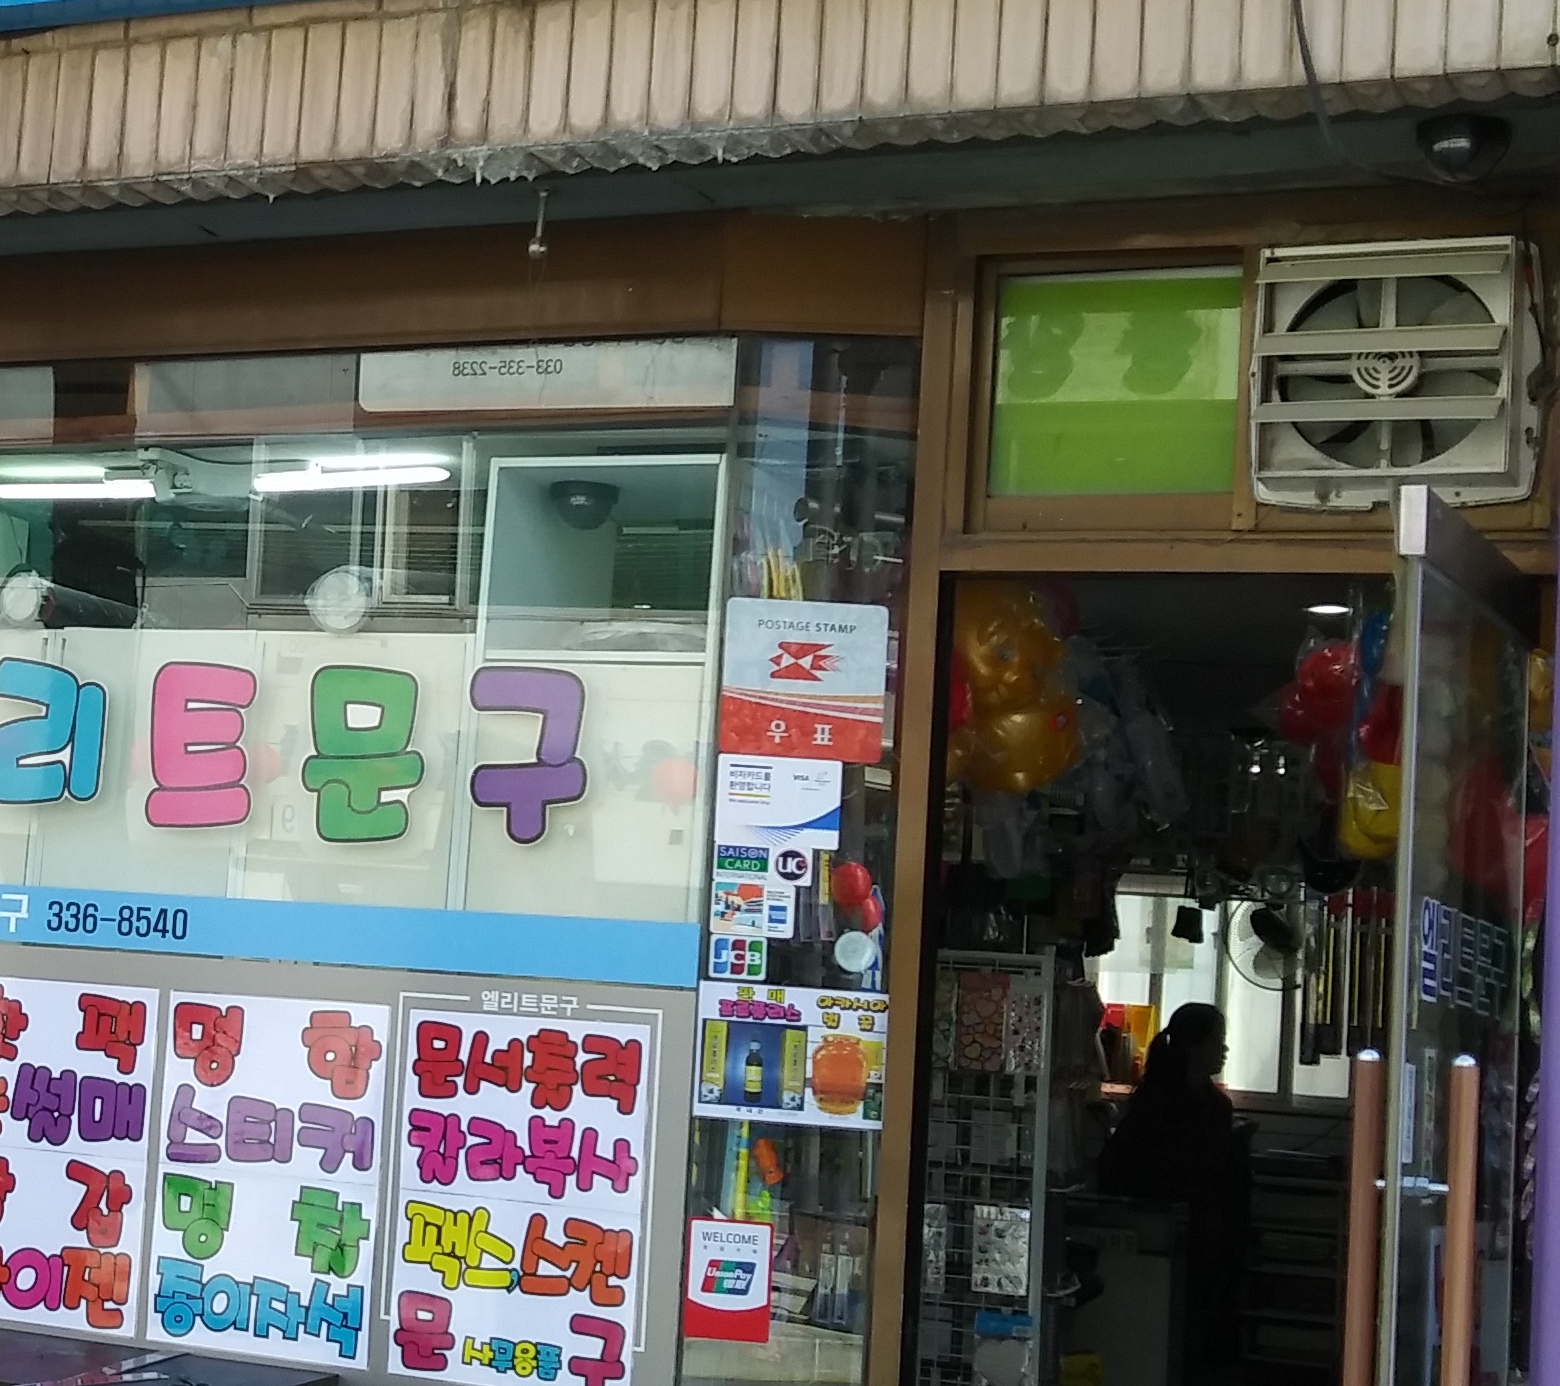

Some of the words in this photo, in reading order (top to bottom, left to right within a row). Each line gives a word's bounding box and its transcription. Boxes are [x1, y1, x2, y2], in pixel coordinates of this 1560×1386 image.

[758, 619, 812, 632] POSTAGE
[815, 622, 858, 634] STAMP
[766, 719, 834, 746] 우표
[719, 846, 768, 859] SAISON
[725, 858, 761, 871] CARD
[778, 856, 807, 875] UC
[46, 898, 190, 943] 336-8540
[1420, 896, 1508, 1021] 엘리트문구
[481, 990, 580, 1017] 엘리트문구
[412, 1020, 642, 1116] 문서출력
[166, 1083, 375, 1174] 스티커
[408, 1107, 639, 1200] 칼라복사
[702, 1231, 759, 1245] WELCOME
[154, 1255, 364, 1361] 종이자석
[462, 1336, 562, 1382] 사무용품
